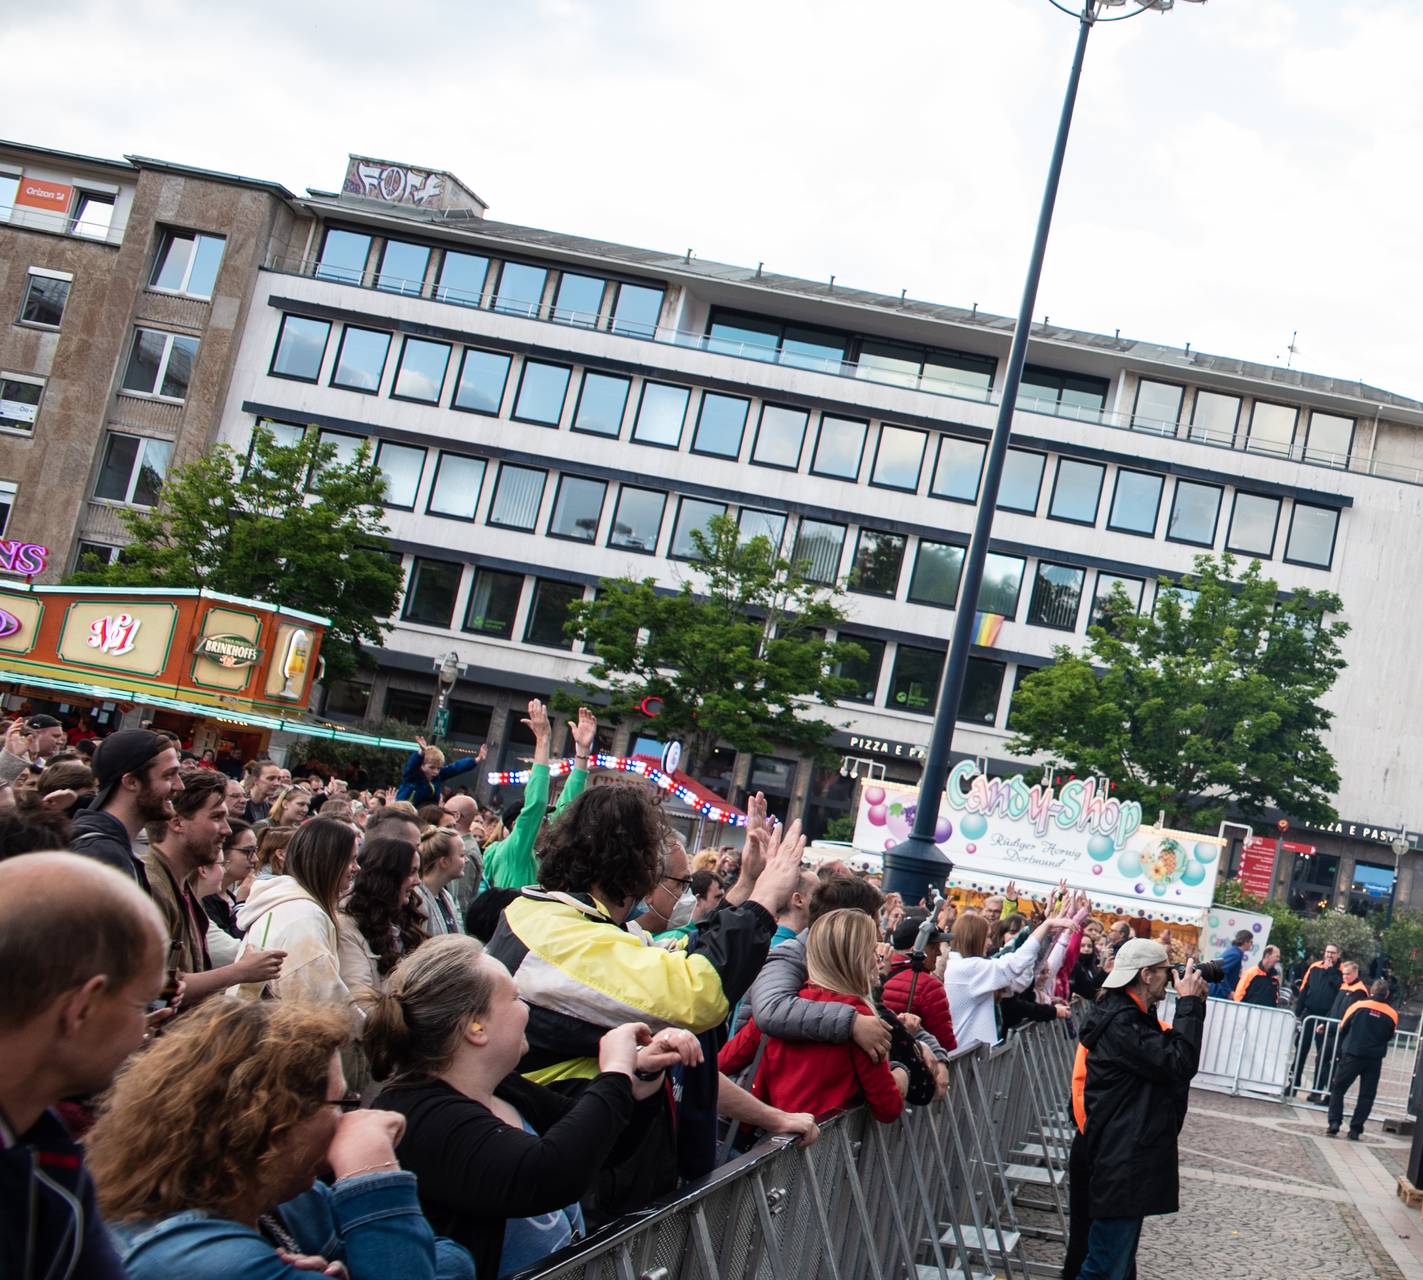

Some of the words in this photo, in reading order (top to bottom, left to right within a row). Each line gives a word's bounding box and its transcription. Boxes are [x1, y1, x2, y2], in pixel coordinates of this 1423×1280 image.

[26, 186, 55, 200] Orizon
[850, 736, 889, 754] PIZZA
[895, 744, 903, 756] E
[946, 759, 1143, 851] Candy-Shop
[1305, 820, 1343, 833] PZZA
[1349, 825, 1357, 836] E
[1003, 848, 1067, 868] Dortmund
